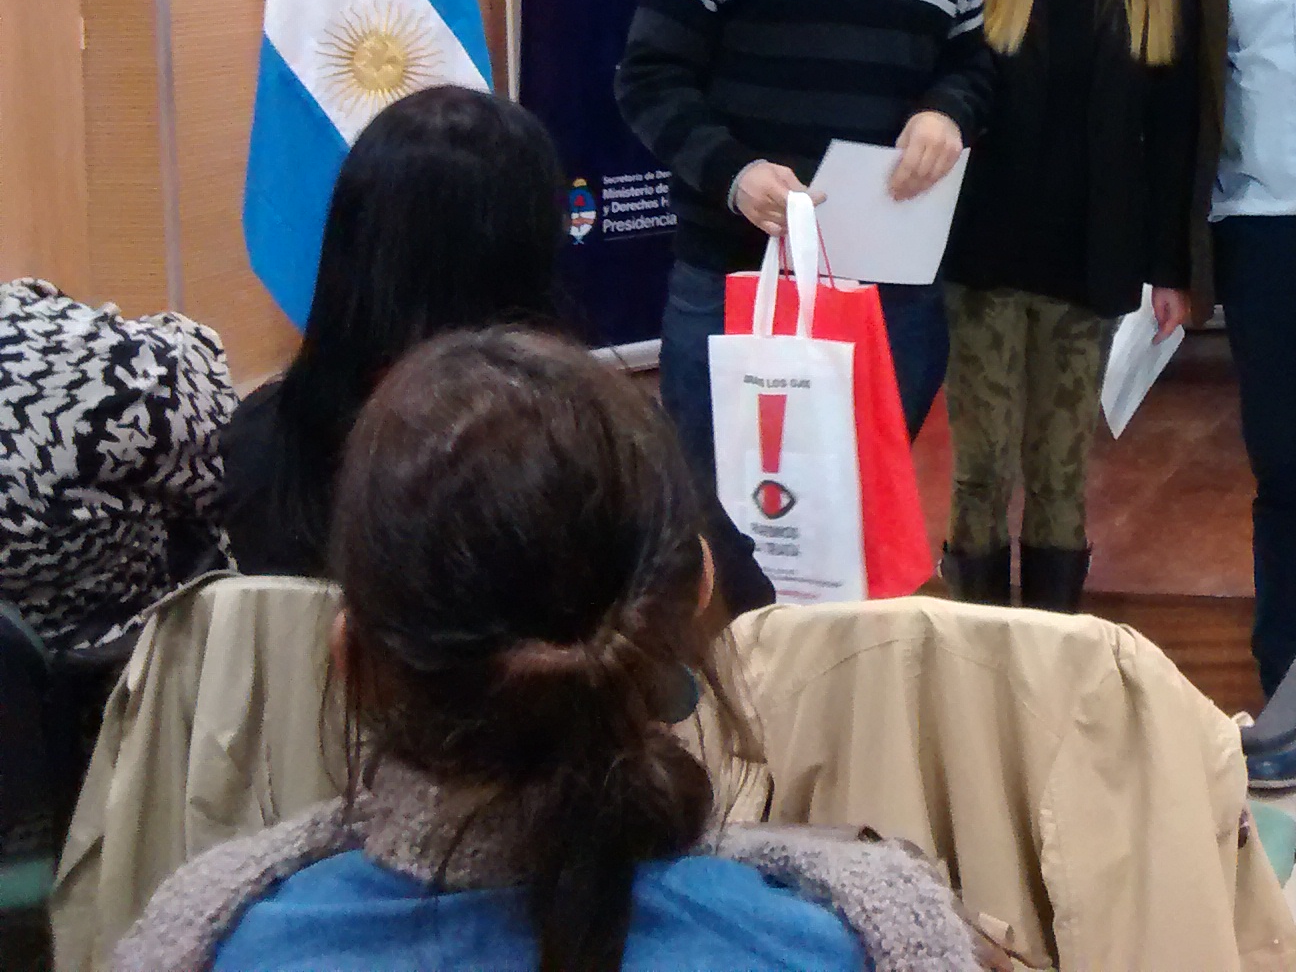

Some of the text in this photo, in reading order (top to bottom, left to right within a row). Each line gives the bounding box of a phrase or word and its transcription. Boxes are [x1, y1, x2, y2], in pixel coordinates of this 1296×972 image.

[602, 183, 669, 201] Ministerio de
[611, 199, 659, 213] Derechos
[603, 213, 678, 234] Presidencia
